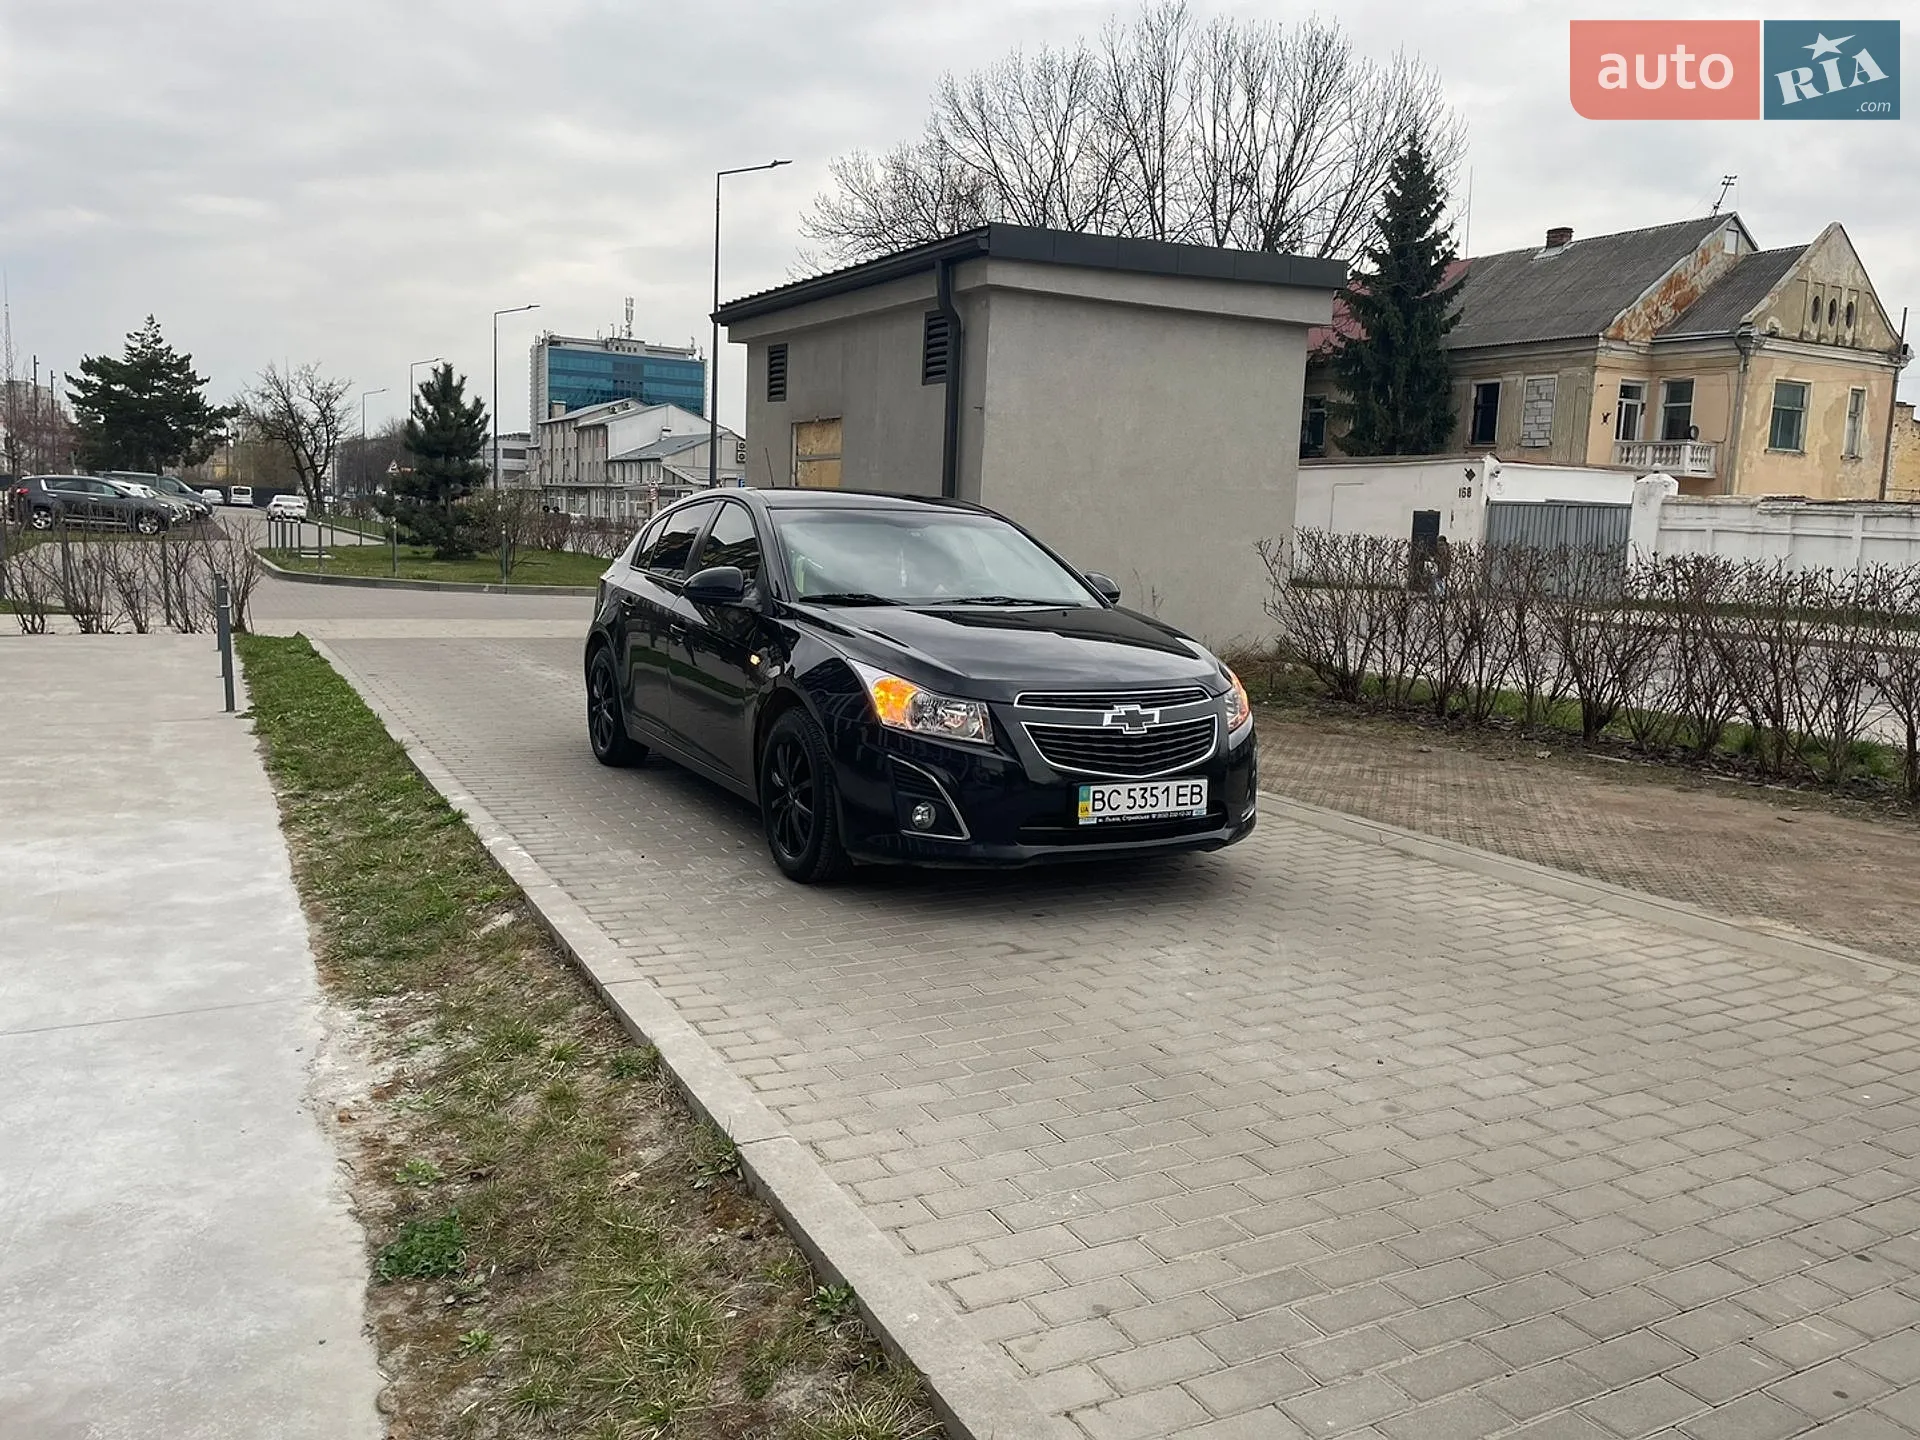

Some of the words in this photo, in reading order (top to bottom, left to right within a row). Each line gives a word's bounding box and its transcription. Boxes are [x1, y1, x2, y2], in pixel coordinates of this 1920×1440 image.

[1458, 486, 1472, 499] 168
[1092, 789, 1122, 812] BC
[1126, 786, 1170, 810] 5351
[1176, 784, 1204, 807] EB
[1080, 805, 1089, 814] UA
